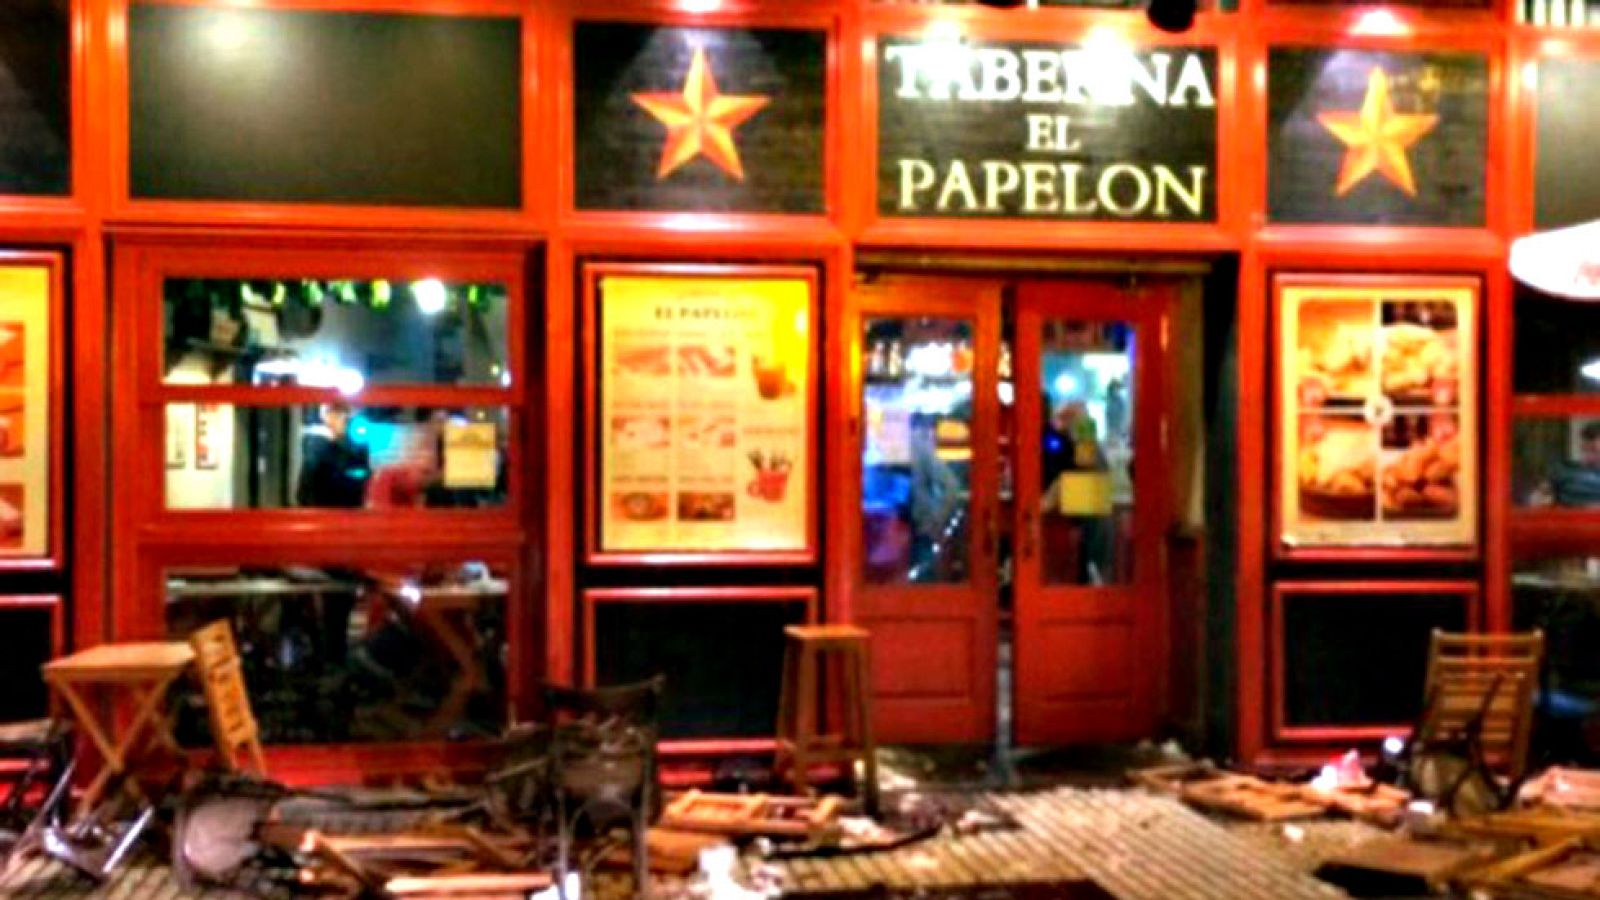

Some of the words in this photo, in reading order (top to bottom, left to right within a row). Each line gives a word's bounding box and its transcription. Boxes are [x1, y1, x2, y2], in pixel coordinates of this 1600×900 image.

[886, 44, 1215, 106] TABERNA
[1026, 113, 1081, 151] EL
[898, 158, 1207, 216] PAPELON
